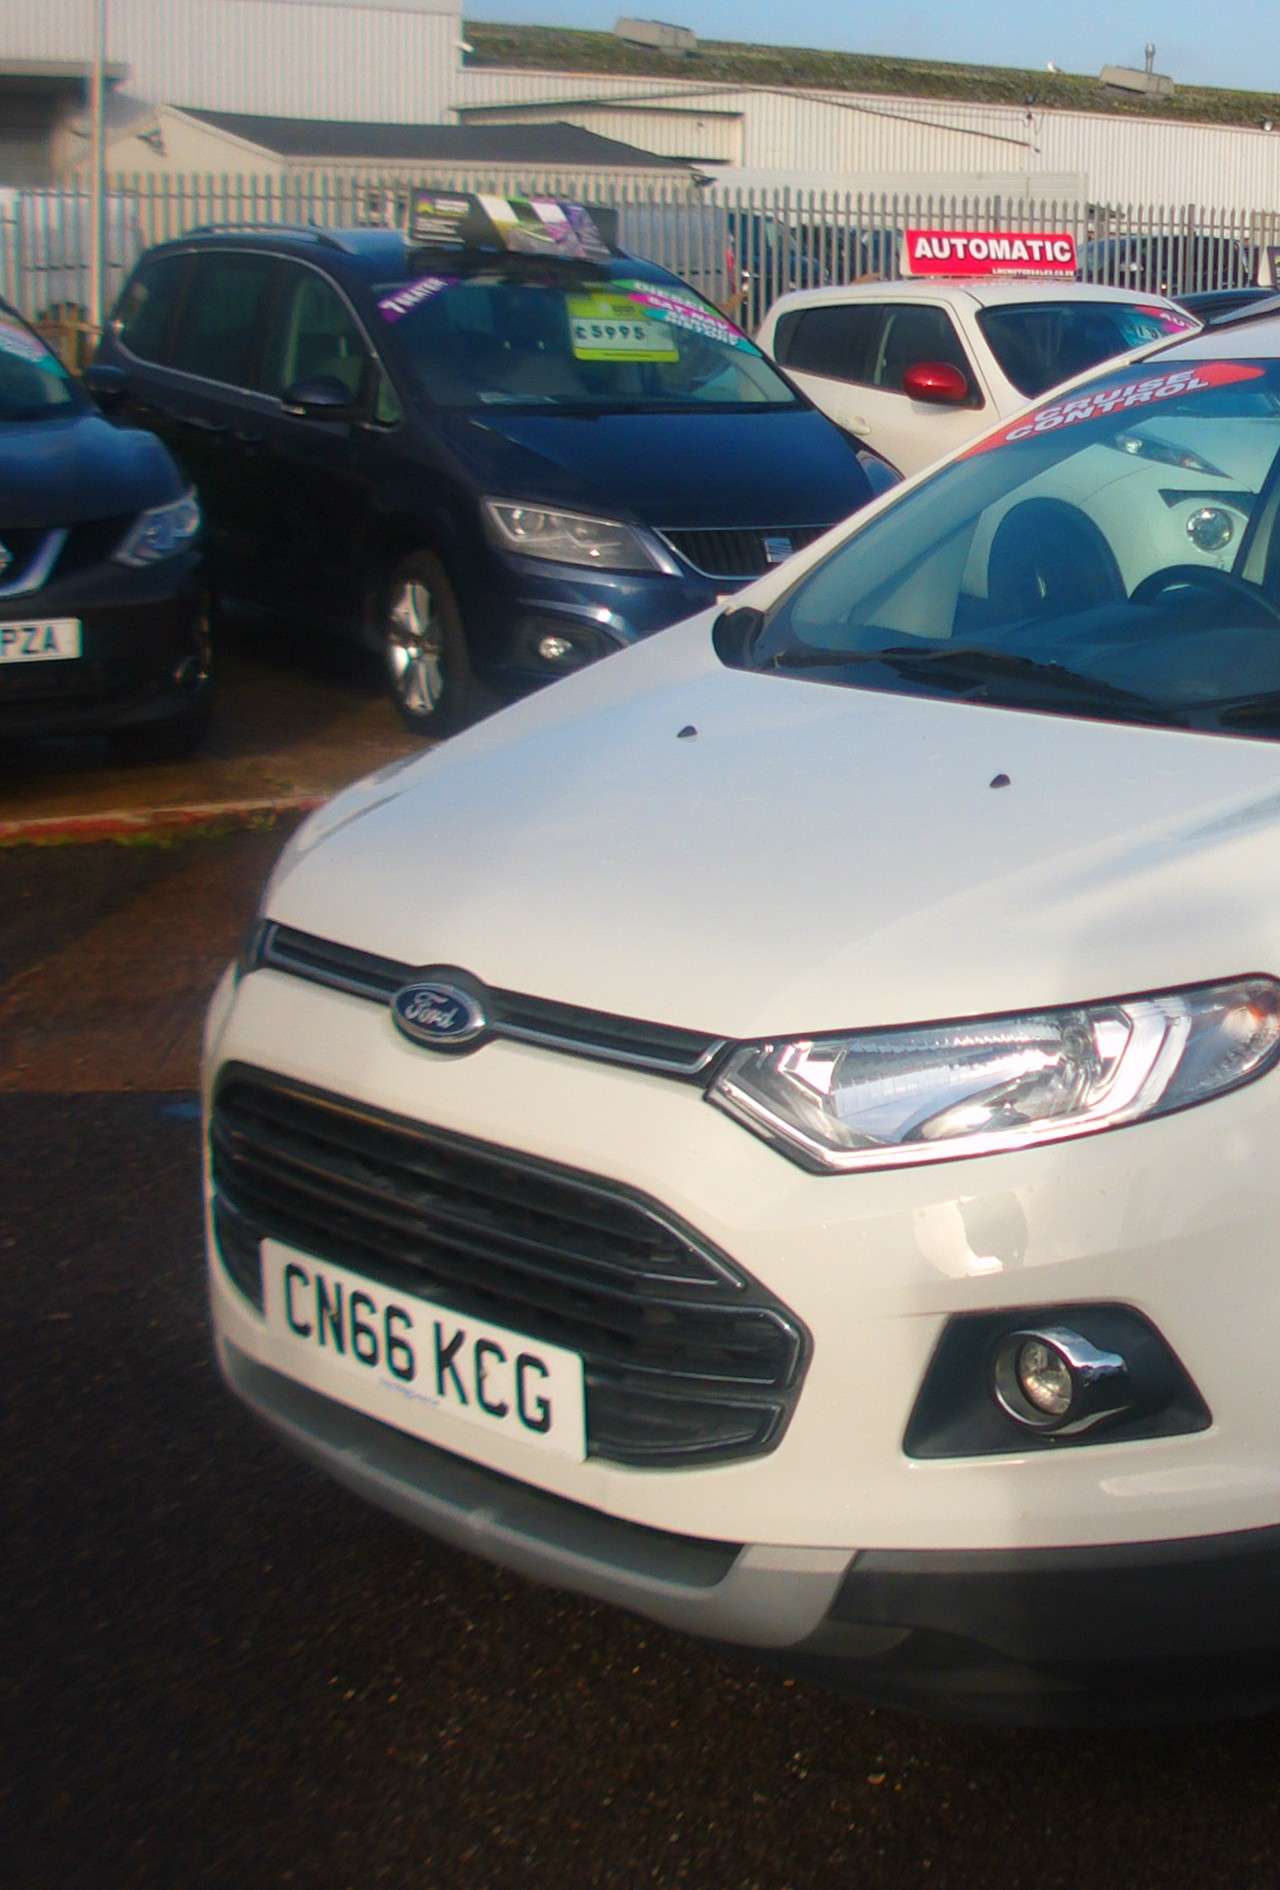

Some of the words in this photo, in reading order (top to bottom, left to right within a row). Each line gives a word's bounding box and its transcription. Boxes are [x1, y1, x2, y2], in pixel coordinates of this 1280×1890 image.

[913, 236, 1072, 262] AUTOMATIC
[1006, 378, 1209, 442] CONTROL
[1034, 369, 1196, 423] CRUISE
[404, 991, 459, 1029] Ford
[284, 1262, 416, 1383] CN66
[432, 1320, 552, 1434] KCG
